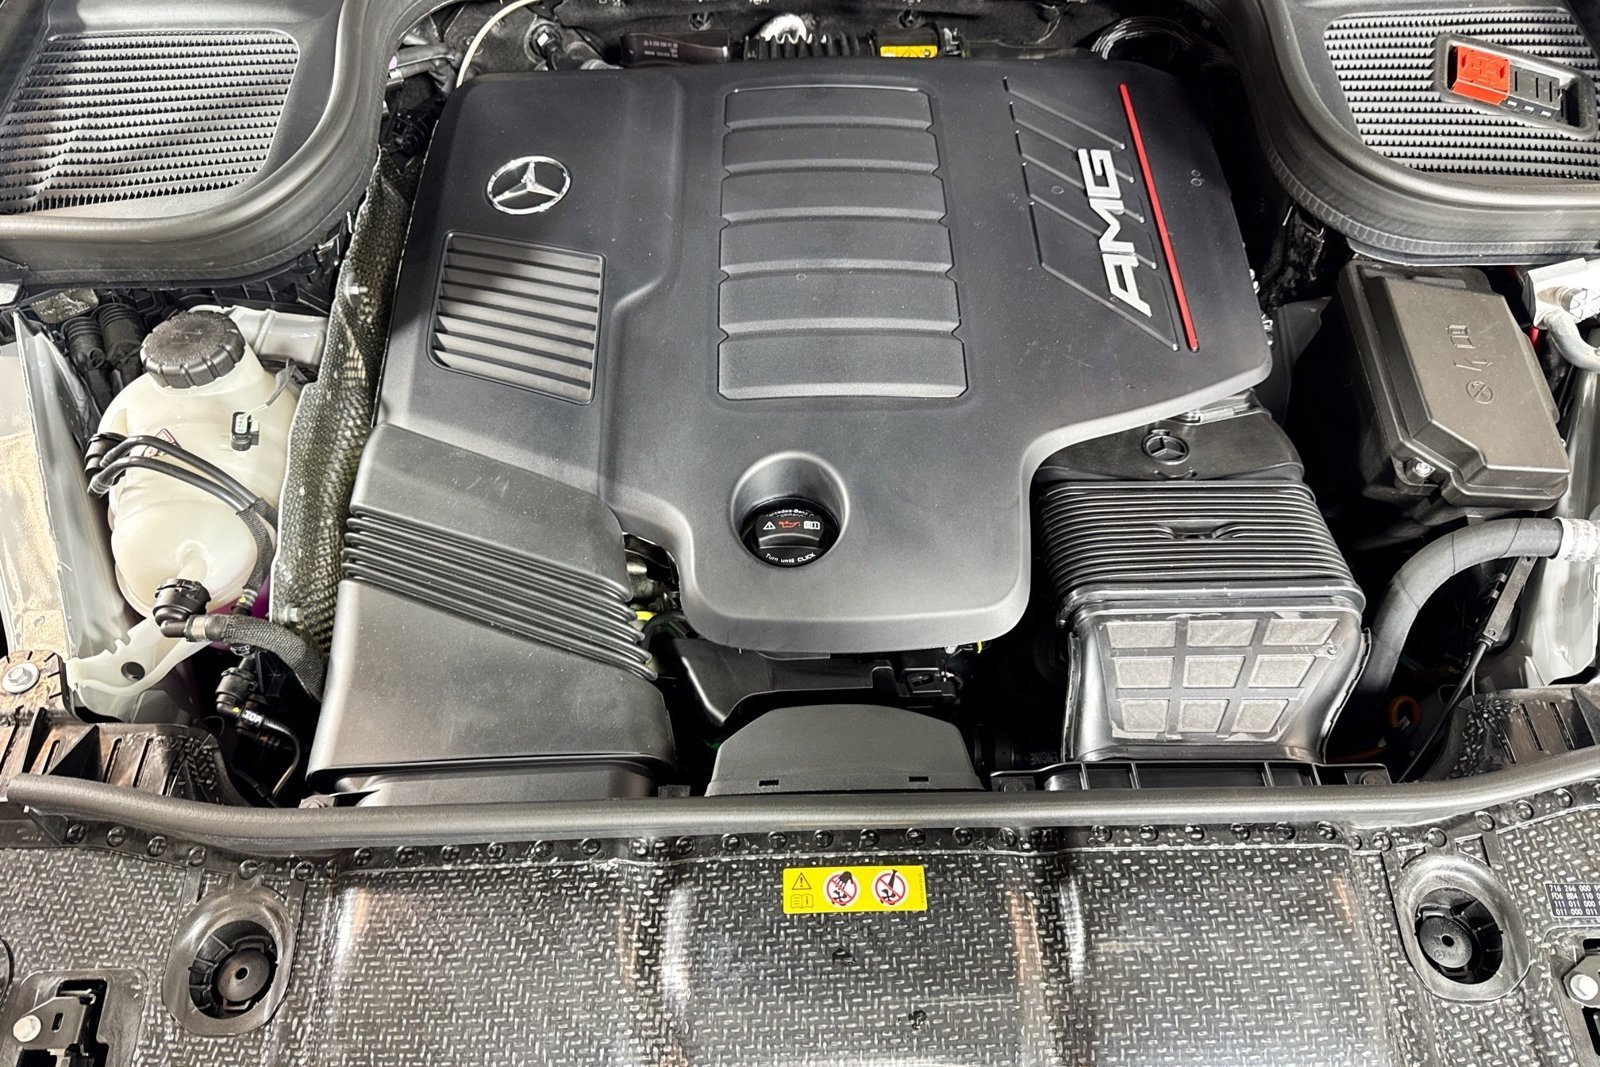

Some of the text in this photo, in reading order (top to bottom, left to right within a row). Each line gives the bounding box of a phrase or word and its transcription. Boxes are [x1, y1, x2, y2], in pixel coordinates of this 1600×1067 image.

[1078, 149, 1152, 318] AMG
[765, 553, 779, 562] Turn
[797, 552, 816, 562] CLICK
[1554, 900, 1565, 908] 111
